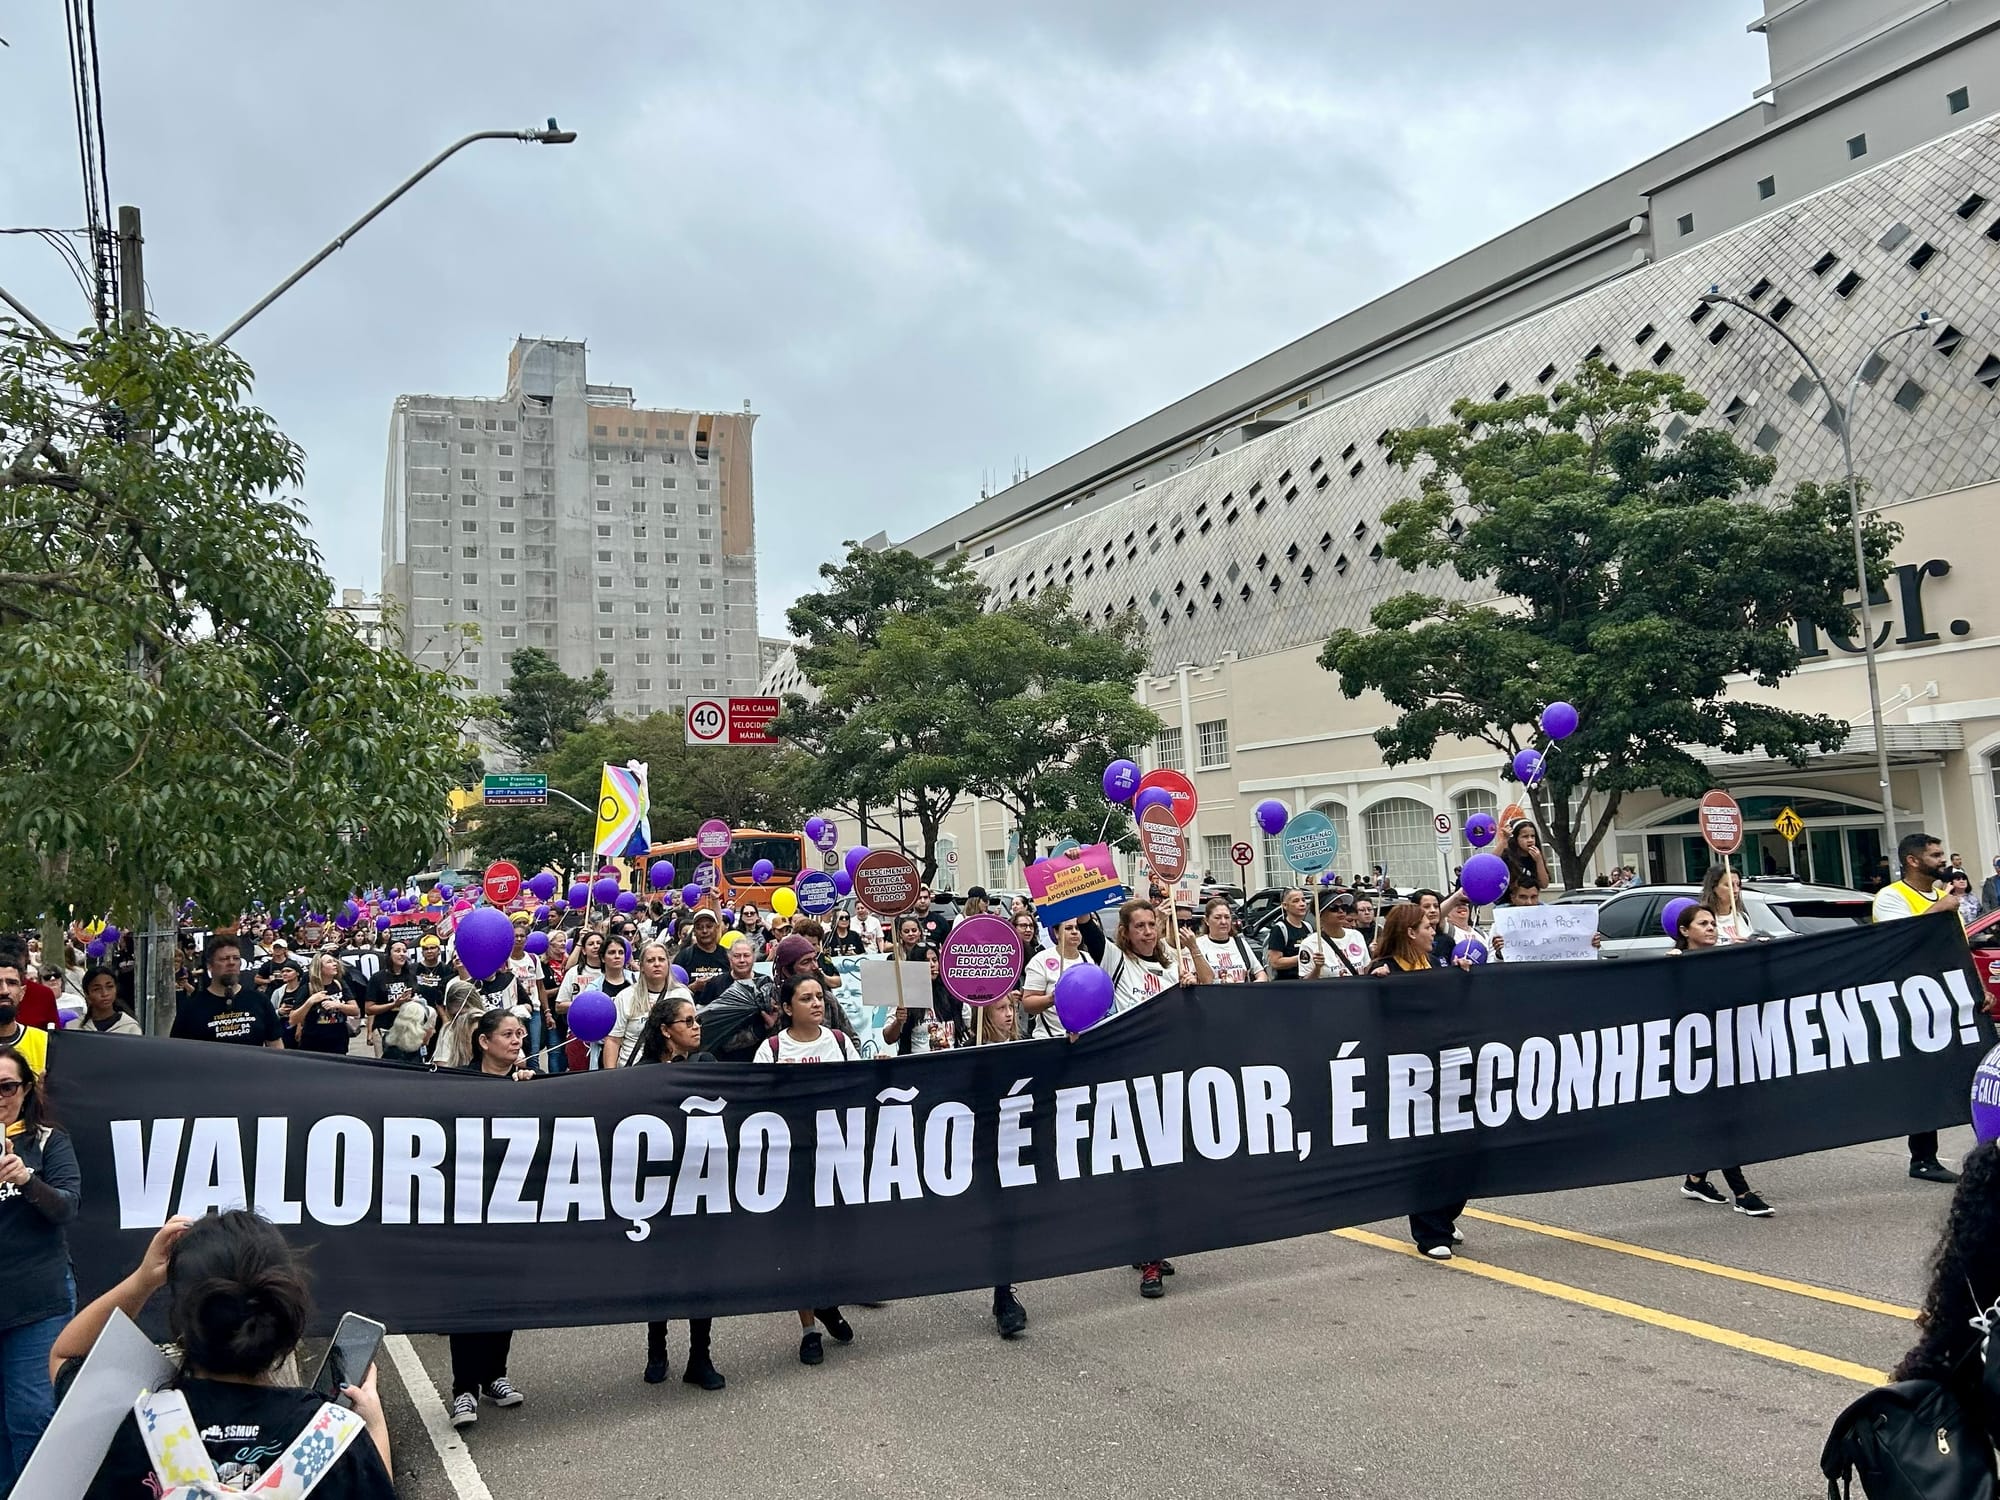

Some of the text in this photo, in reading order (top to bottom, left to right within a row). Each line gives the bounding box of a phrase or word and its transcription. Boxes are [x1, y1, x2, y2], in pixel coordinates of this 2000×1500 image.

[731, 703, 776, 712] ÁREA CALMA
[695, 710, 718, 726] 40
[1144, 822, 1180, 836] CRESCIMENTO
[1151, 833, 1176, 845] VERTICAL
[1294, 839, 1327, 852] DESCARTE
[1290, 846, 1333, 861] MEU DIPLOMA
[859, 866, 912, 877] CRESCIMENTO
[1057, 866, 1080, 878] FIM DO
[868, 876, 905, 885] VERTICAL
[1048, 870, 1098, 892] CONFISCO DAS
[887, 884, 912, 892] TODAS
[1047, 876, 1106, 902] APOSENTADORIAS
[880, 893, 906, 901] TODOS
[1507, 916, 1516, 929] A
[1521, 917, 1548, 929] MINHA
[951, 944, 1015, 955] SALA LOTADA,
[957, 954, 1009, 967] EDUCAÇÃO
[949, 968, 1014, 977] PRECARIZADA
[110, 969, 1980, 1241] VALORIZAÇÃO NÃO É FAVOR, É RECONHECIMENTO!
